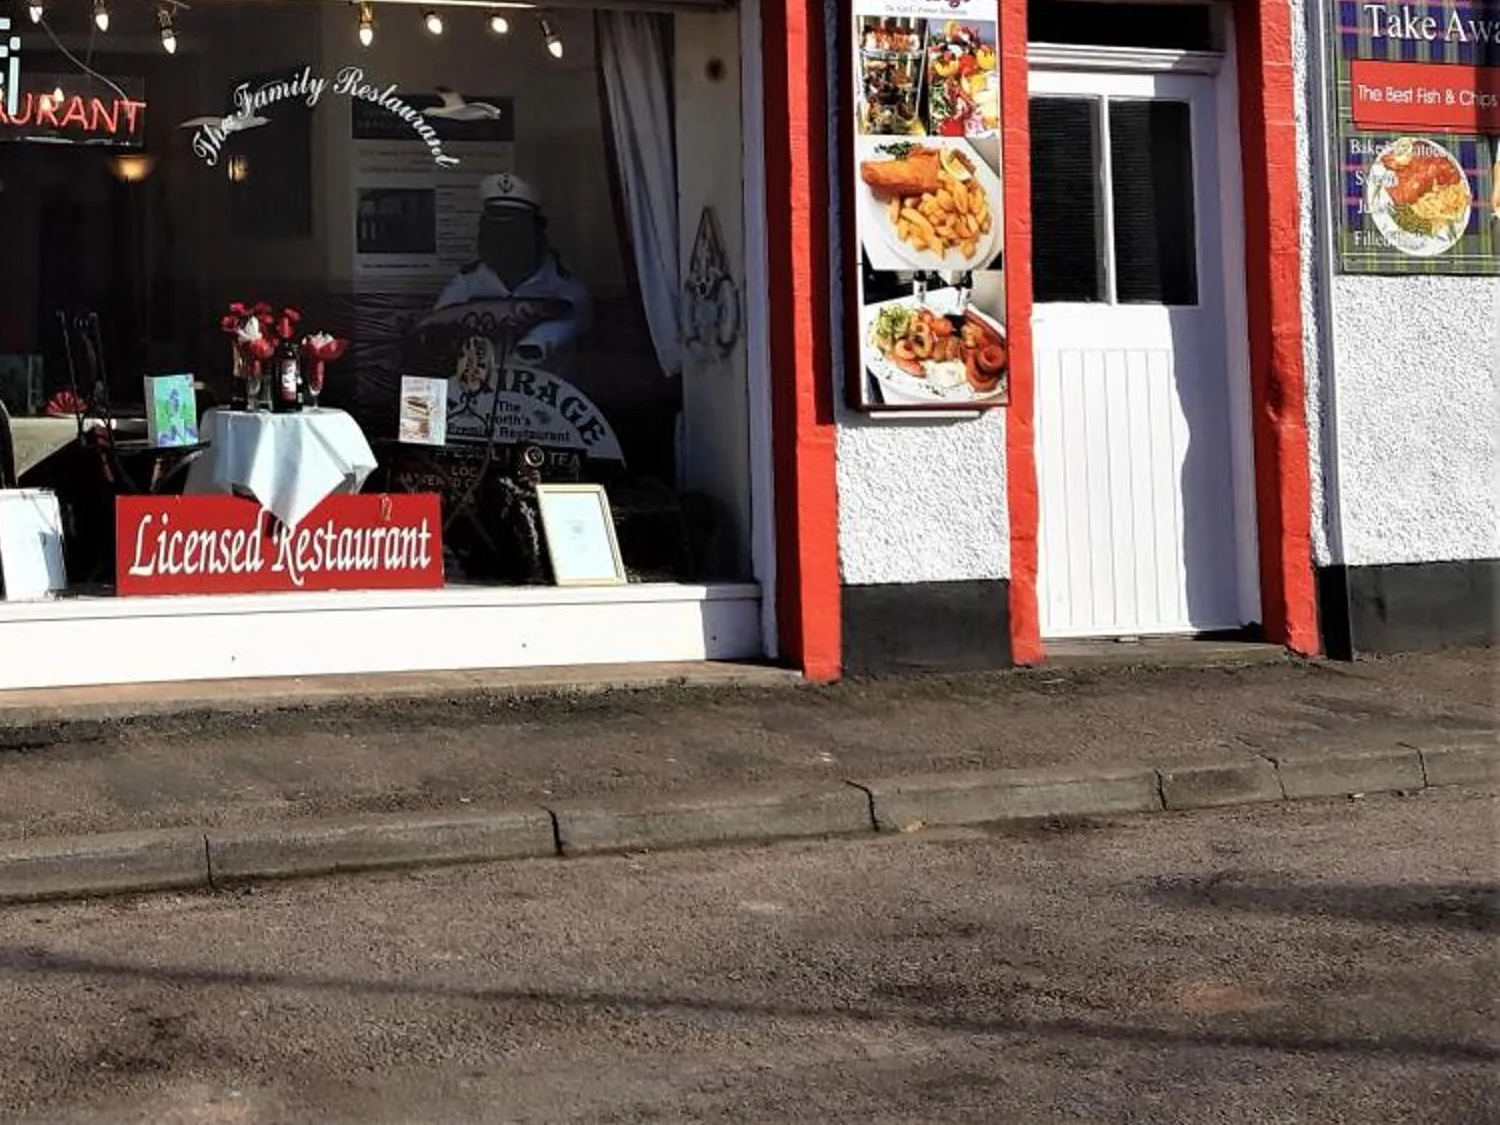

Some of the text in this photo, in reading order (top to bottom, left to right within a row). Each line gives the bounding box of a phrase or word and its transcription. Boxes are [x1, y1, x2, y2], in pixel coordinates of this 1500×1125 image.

[1363, 4, 1437, 41] Take
[233, 67, 326, 119] Family
[333, 67, 460, 168] Restaurant
[1357, 84, 1498, 108] The Best Fish & Chips
[129, 504, 432, 587] Licensed Restaurant
